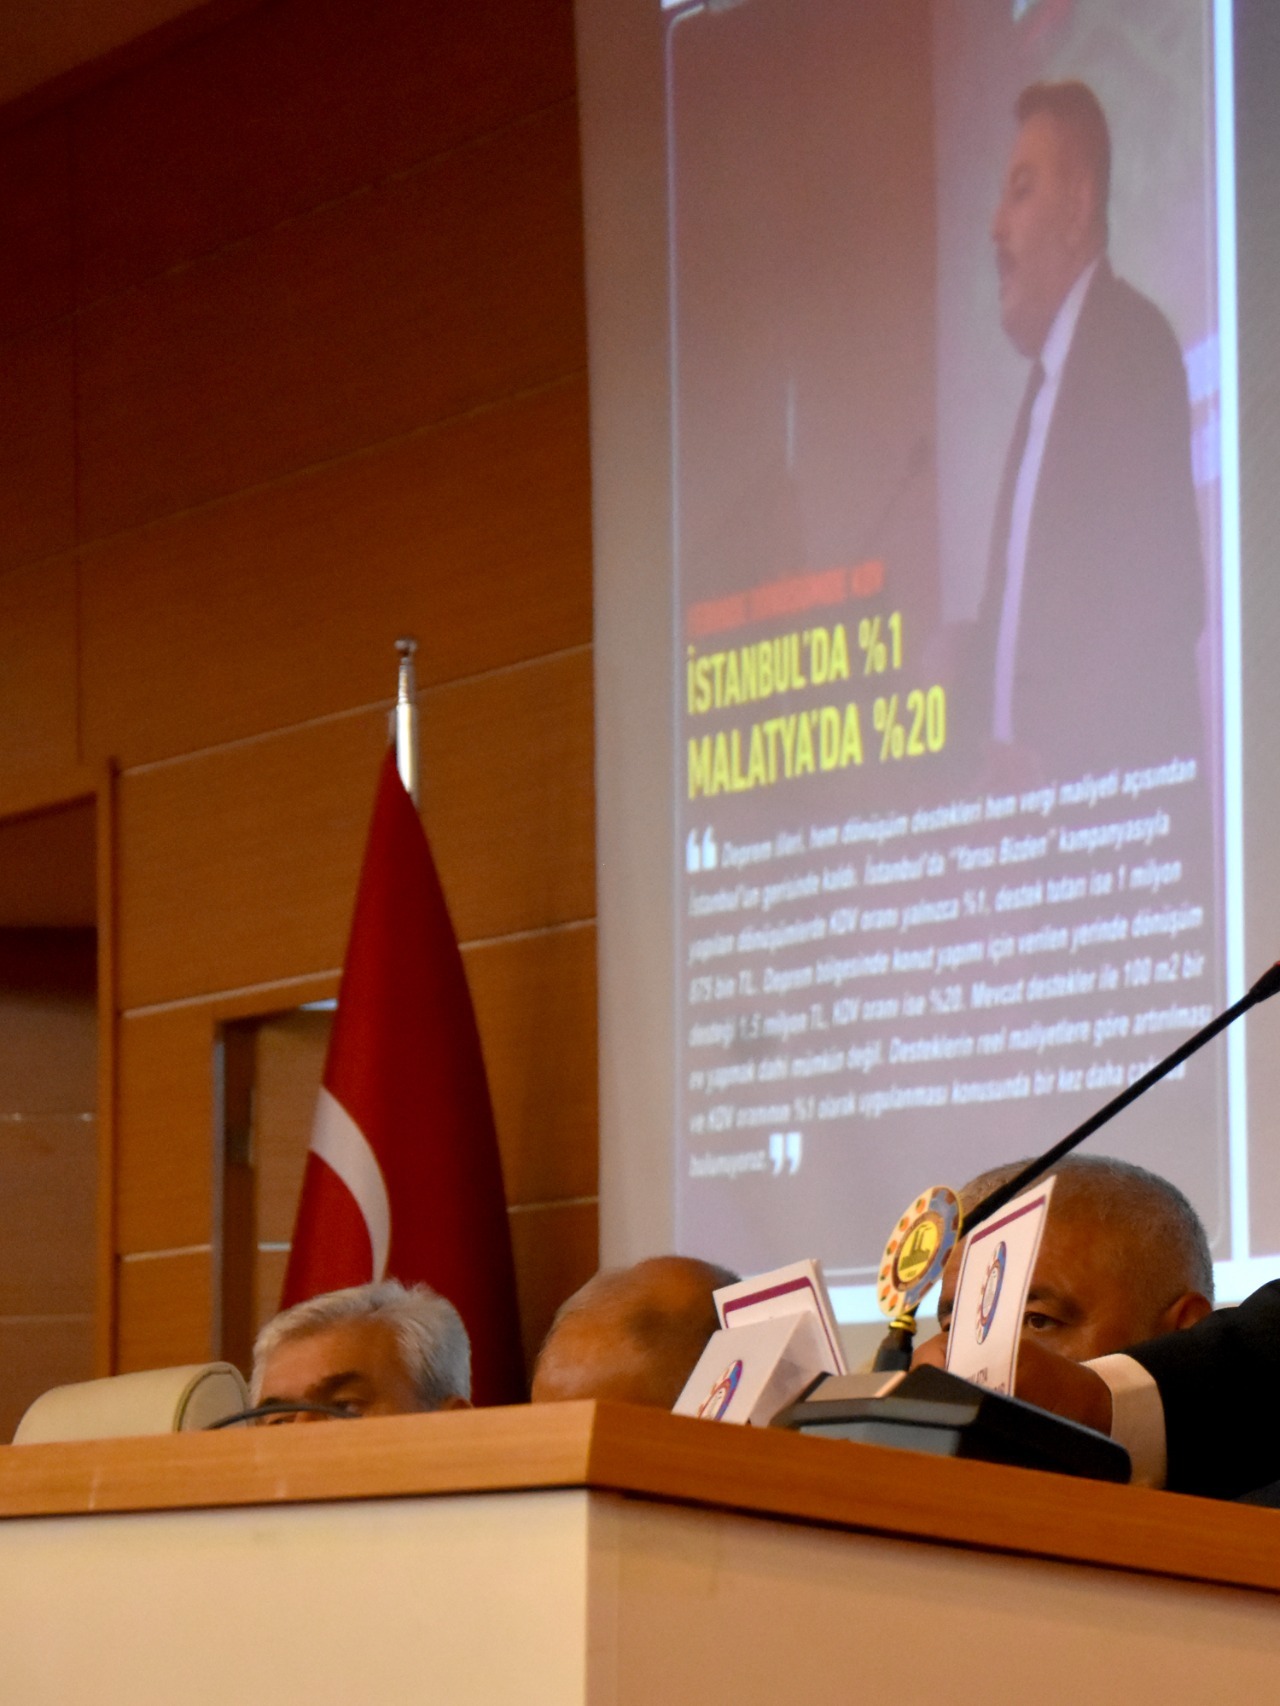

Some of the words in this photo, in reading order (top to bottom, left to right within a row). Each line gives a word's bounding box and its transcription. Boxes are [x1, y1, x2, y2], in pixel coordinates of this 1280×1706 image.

[687, 623, 850, 716] İSTANBUL'DA
[858, 611, 902, 676] %1
[687, 702, 863, 801] MALATYA'DA
[873, 684, 947, 764] %20
